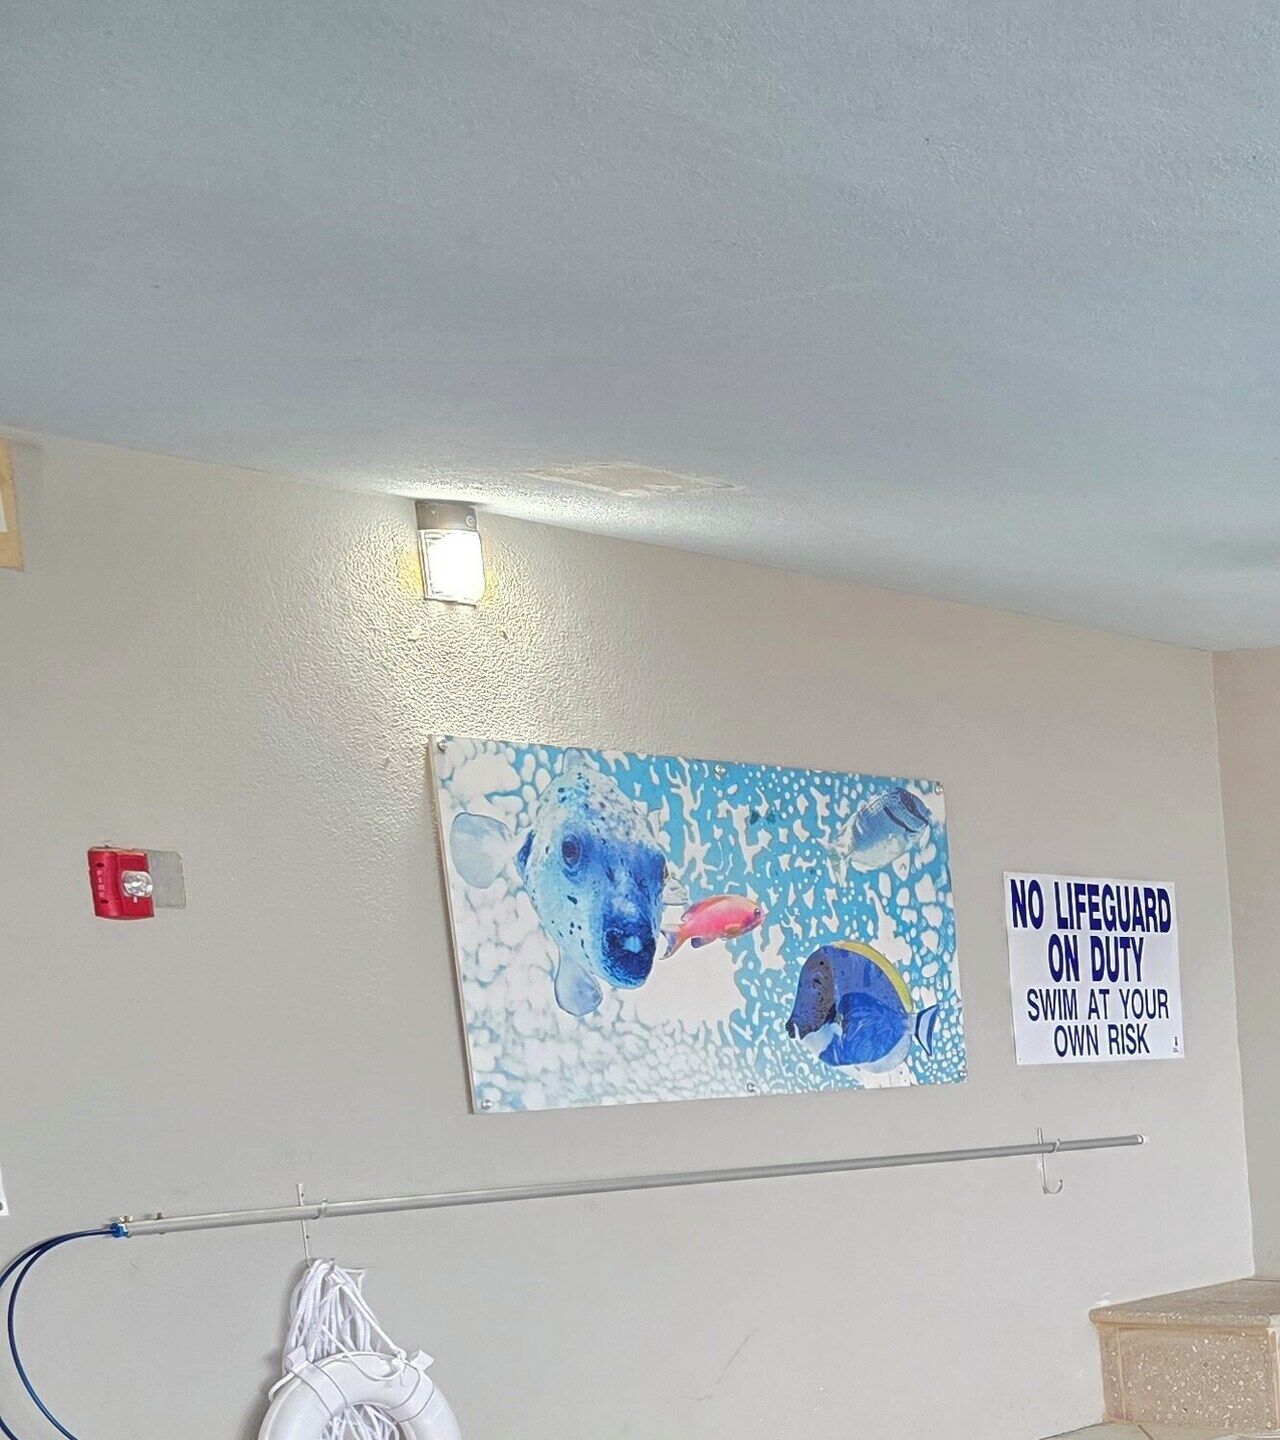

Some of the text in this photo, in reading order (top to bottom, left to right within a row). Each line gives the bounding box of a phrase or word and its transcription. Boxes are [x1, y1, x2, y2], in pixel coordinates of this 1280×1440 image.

[1010, 879, 1171, 933] NO LIFEGUARD
[1048, 934, 1144, 982] ON DUTY
[1026, 988, 1169, 1021] SWIM AT YOUR
[1054, 1023, 1151, 1058] OWN RISK
